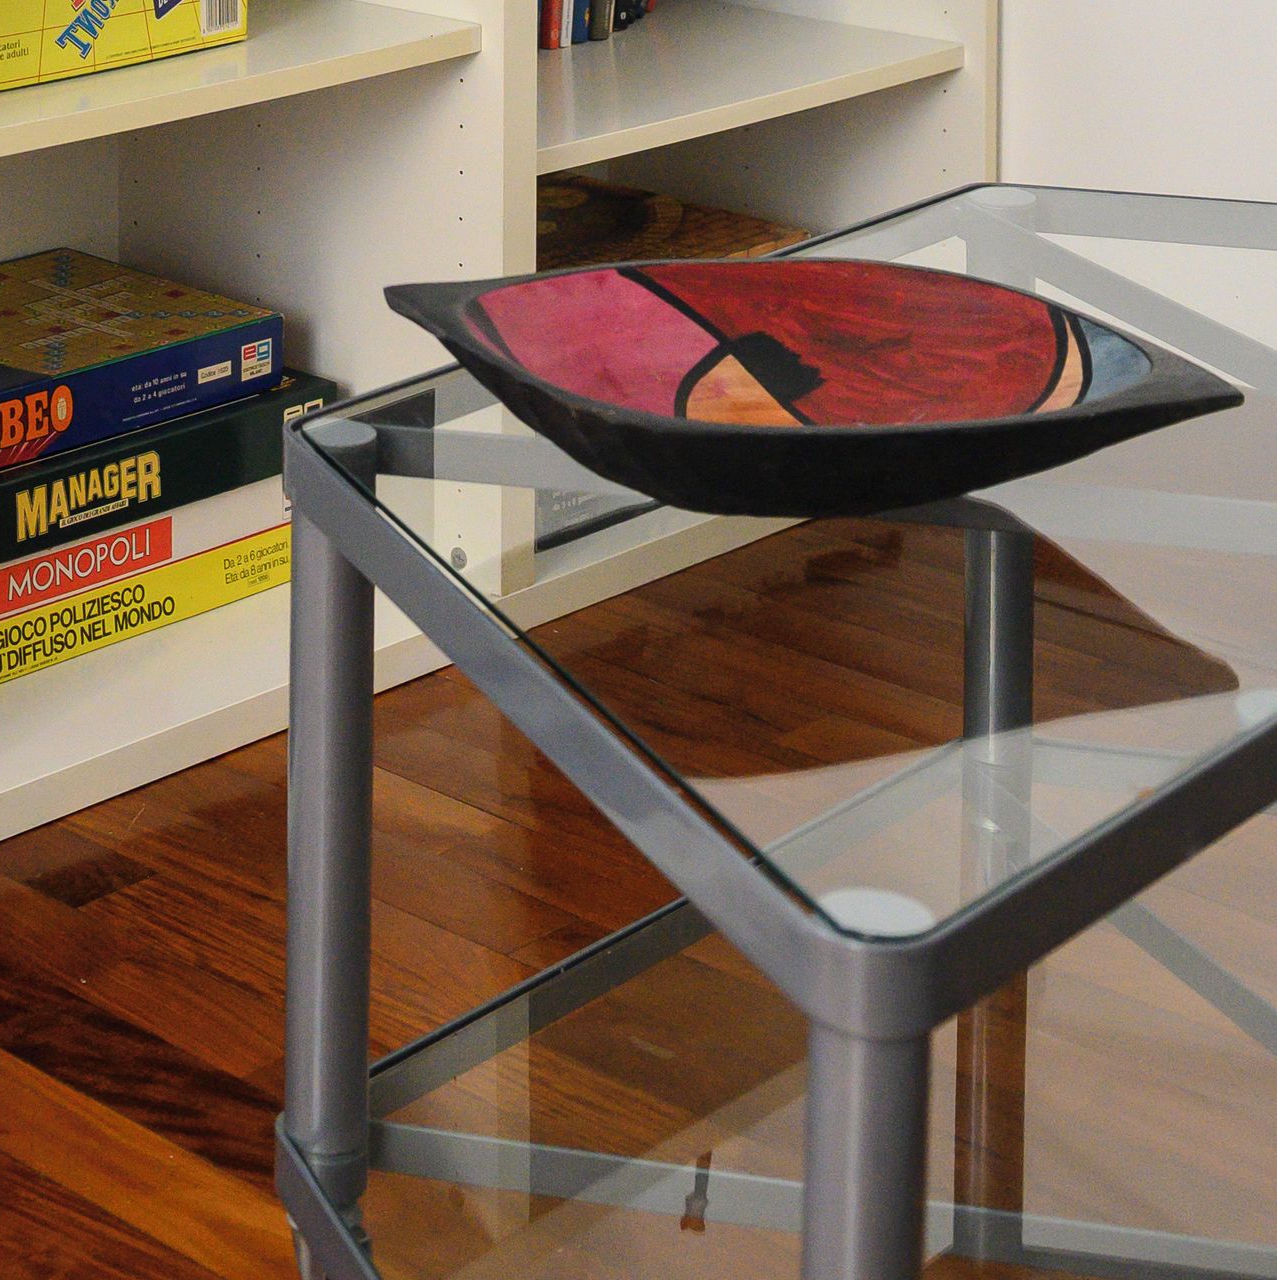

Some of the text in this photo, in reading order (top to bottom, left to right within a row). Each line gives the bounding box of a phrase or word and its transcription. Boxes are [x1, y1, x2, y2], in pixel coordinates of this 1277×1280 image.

[6, 47, 29, 60] adulti
[158, 382, 186, 398] giocatori
[16, 450, 162, 542] MANAGER
[8, 527, 151, 601] MONOPOLI
[223, 558, 235, 570] Da
[237, 554, 242, 566] 2
[243, 554, 249, 564] a
[250, 550, 255, 561] 6
[240, 568, 249, 580] da
[250, 564, 256, 576] 8
[257, 559, 272, 574] anni
[50, 584, 145, 632] POLIZIESCO
[7, 634, 77, 670] DIFFUSO
[80, 618, 112, 645] NEL
[114, 596, 175, 632] MONDO
